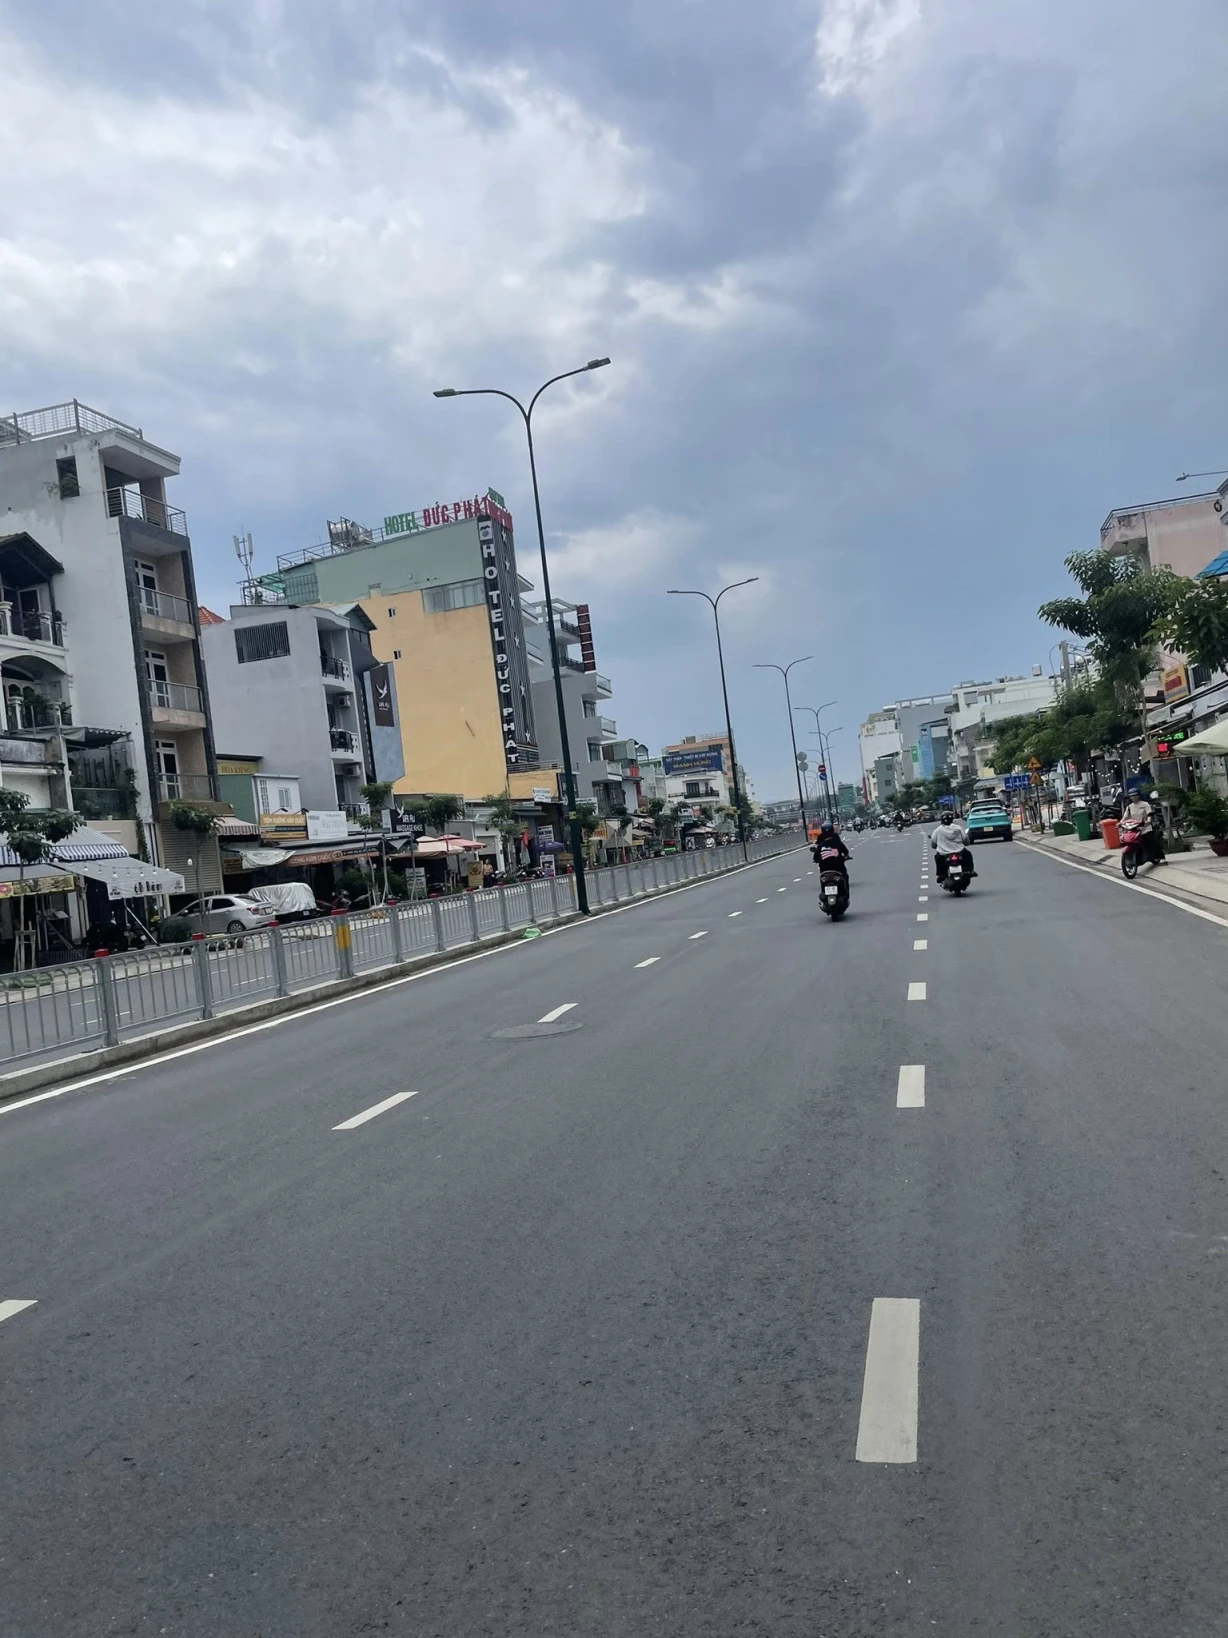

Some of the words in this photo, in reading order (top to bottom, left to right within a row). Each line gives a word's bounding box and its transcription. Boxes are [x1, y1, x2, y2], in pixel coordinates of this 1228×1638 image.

[384, 512, 418, 535] HOTEL
[423, 501, 450, 527] ĐỨC
[453, 494, 489, 521] PHÁT
[482, 543, 505, 642] HOTEL
[496, 654, 511, 693] ĐỨC
[502, 707, 520, 763] PHÁT
[396, 824, 413, 832] MASSAGE
